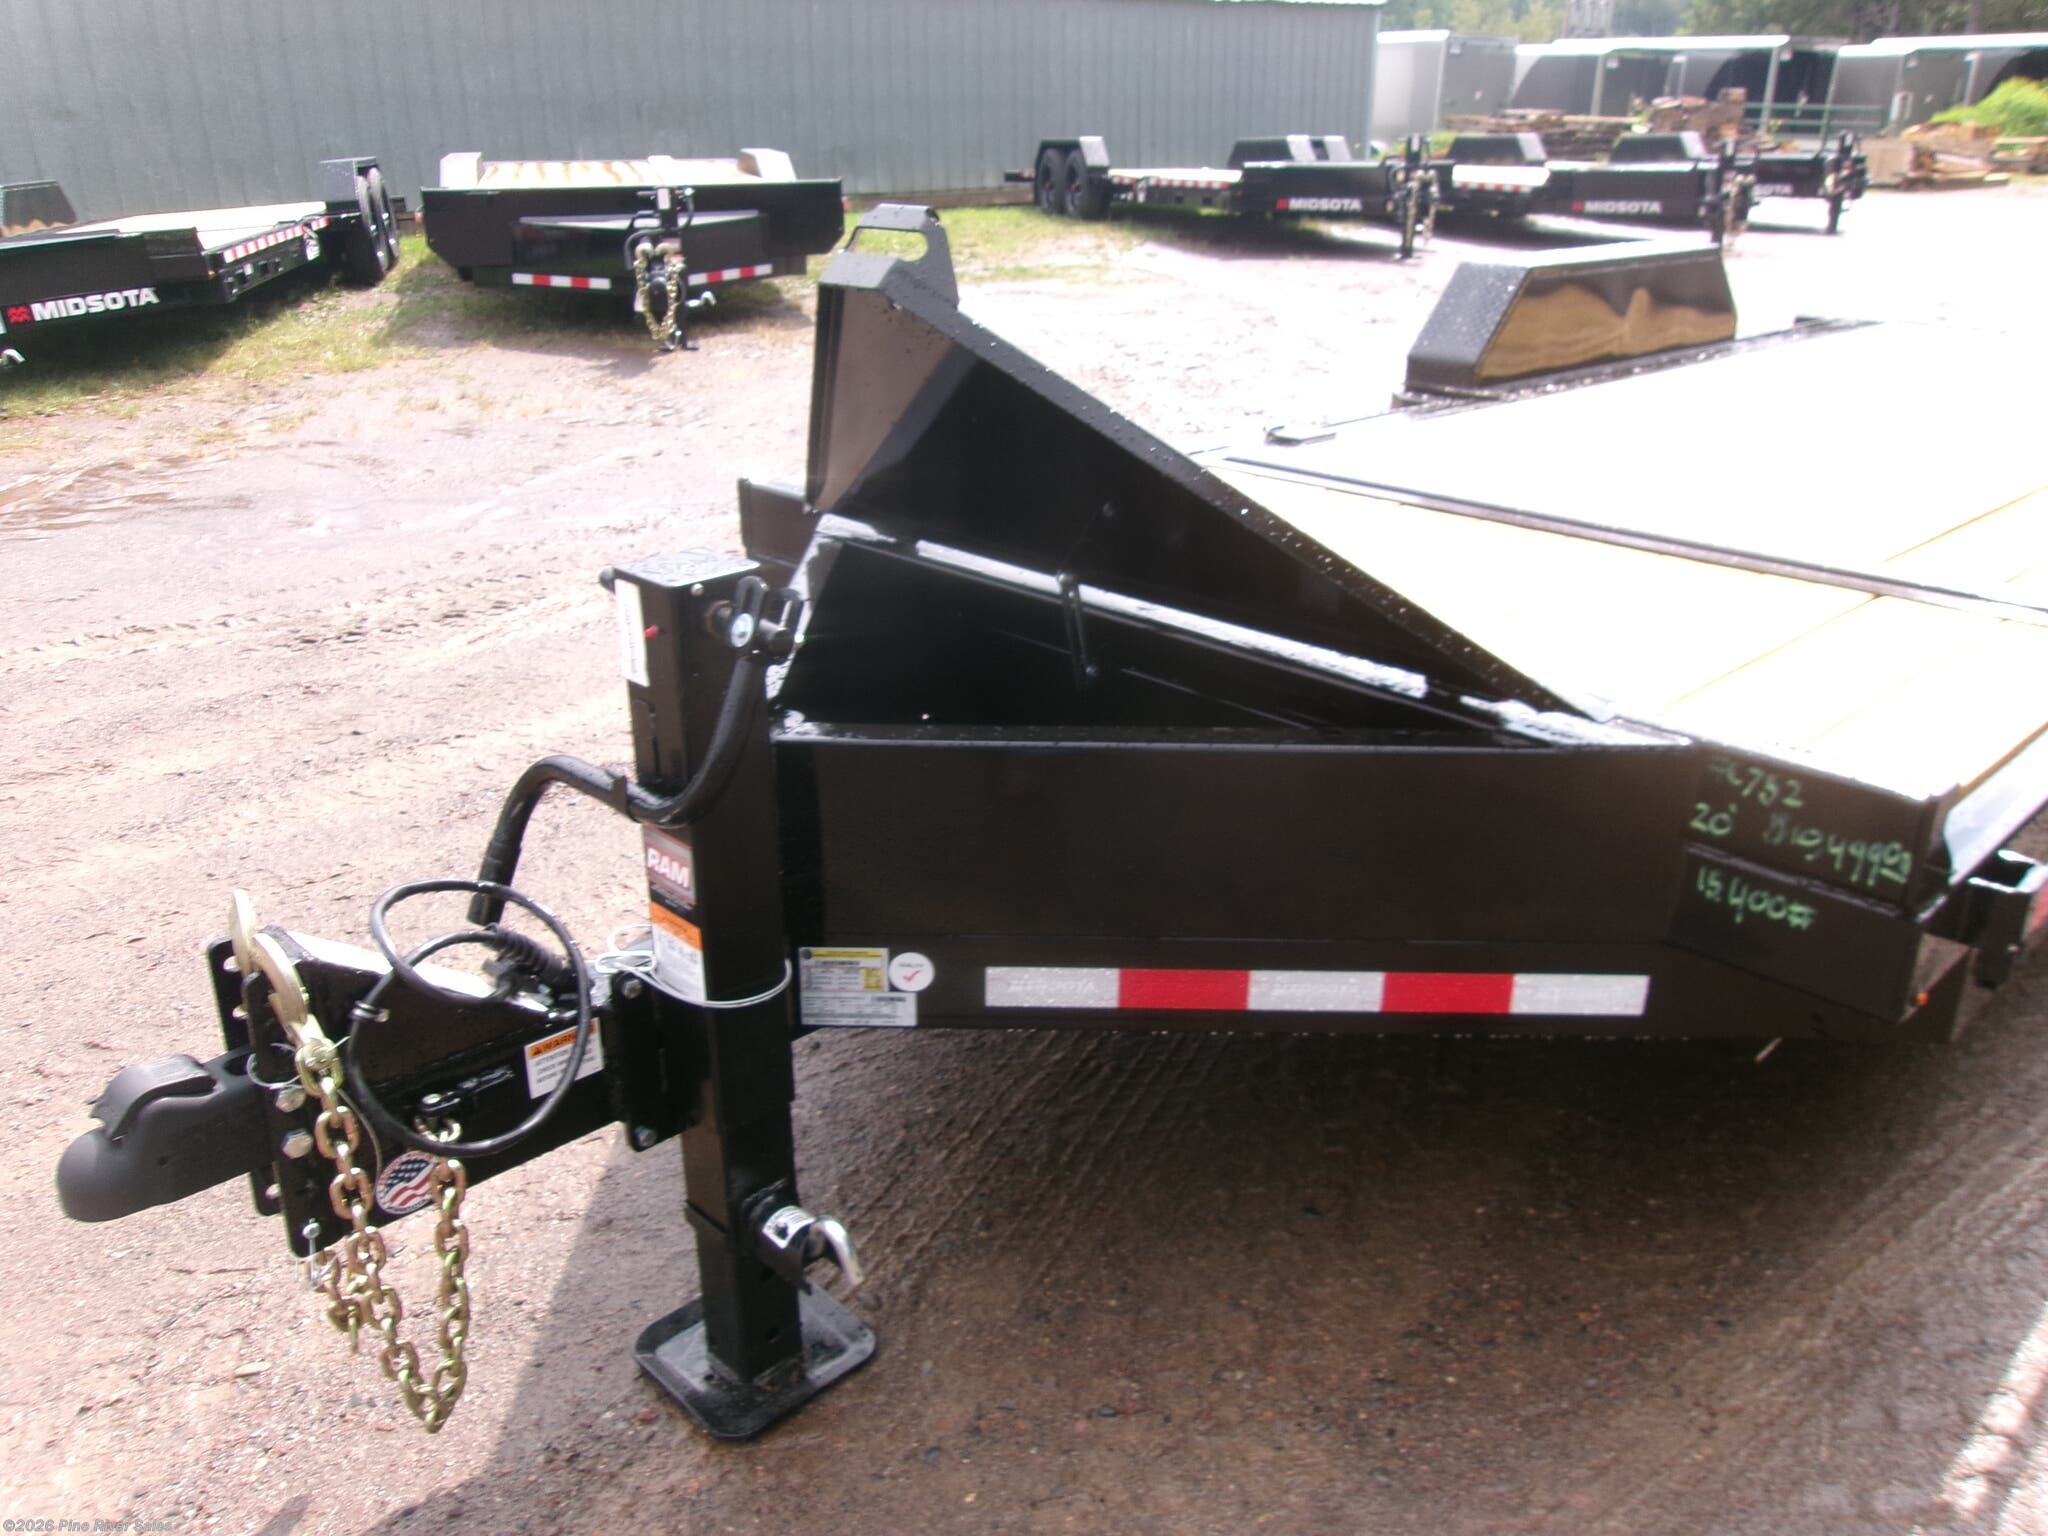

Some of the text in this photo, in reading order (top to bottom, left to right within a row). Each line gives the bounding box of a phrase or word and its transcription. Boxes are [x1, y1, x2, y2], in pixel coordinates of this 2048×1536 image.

[1288, 197, 1362, 211] MIDSOTA
[1583, 200, 1662, 214] MIDSOTA
[30, 287, 160, 322] MIDSOTA
[646, 847, 690, 889] RAM
